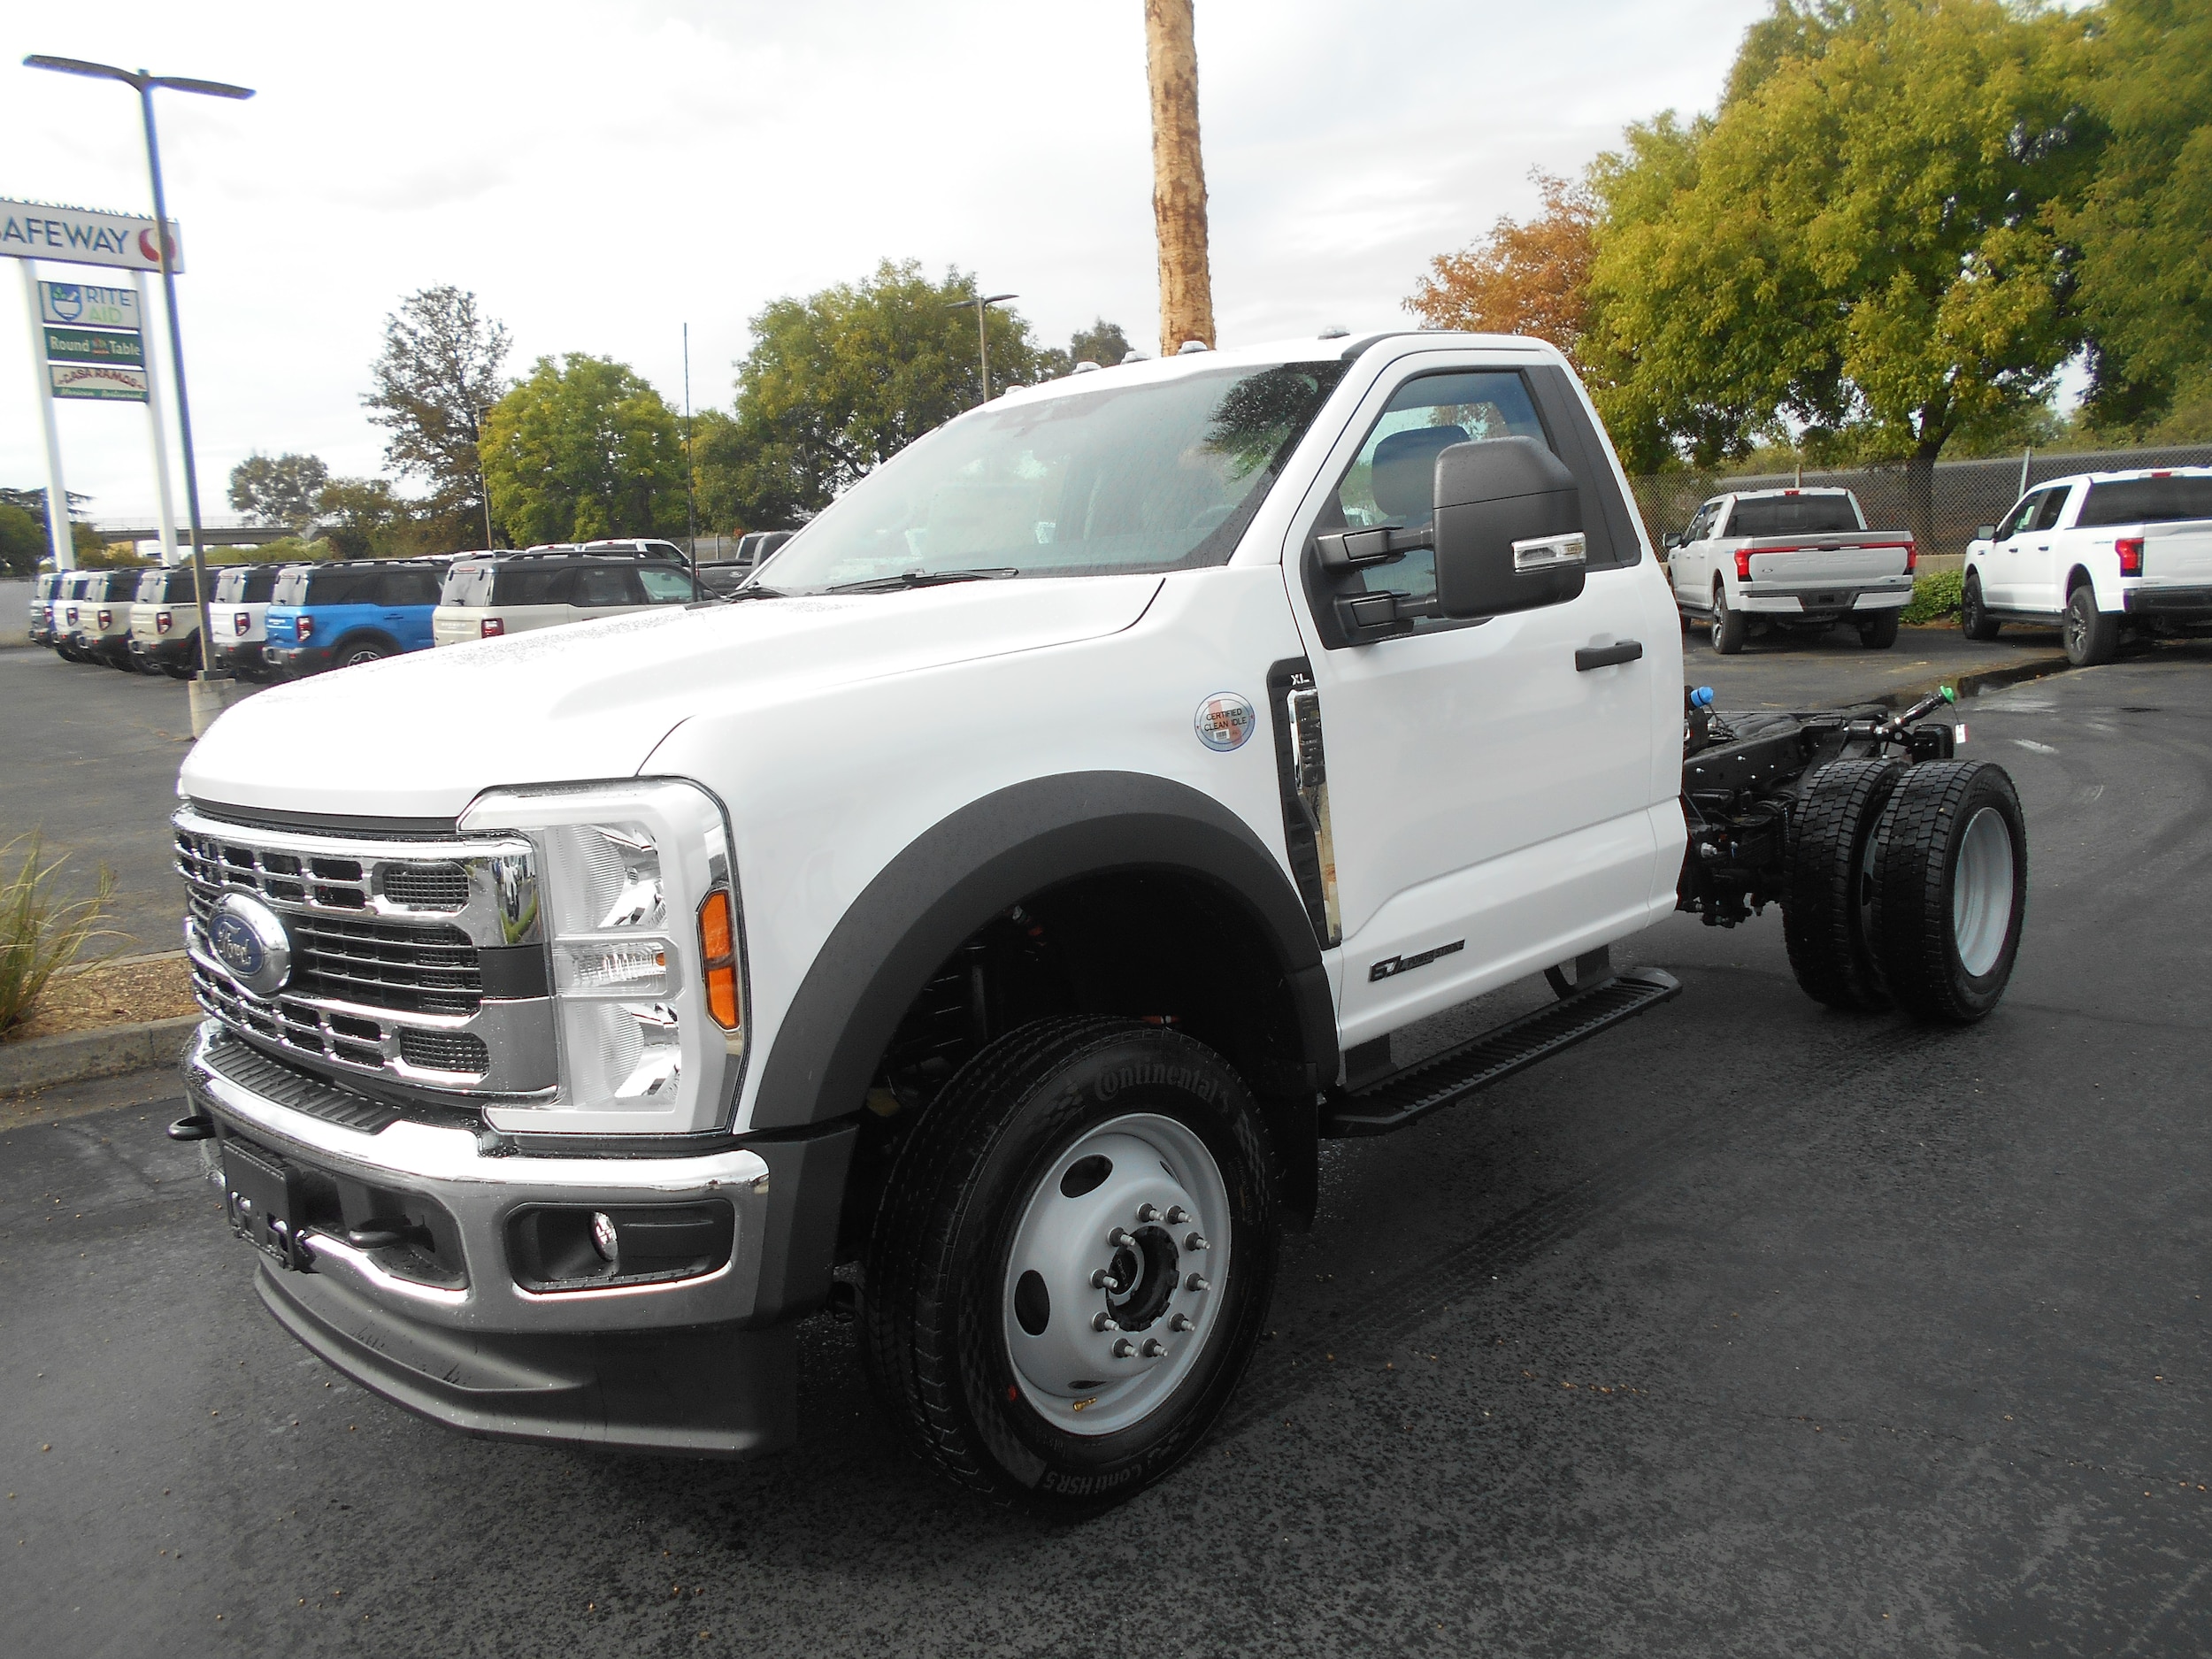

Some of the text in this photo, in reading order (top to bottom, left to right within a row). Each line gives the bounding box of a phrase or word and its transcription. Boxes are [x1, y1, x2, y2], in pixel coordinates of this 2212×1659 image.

[0, 217, 130, 255] AFEWAY
[85, 288, 132, 306] RITE
[88, 307, 122, 324] AID
[50, 335, 142, 356] Round Table
[96, 368, 138, 388] RAMOS
[1290, 672, 1310, 686] XL
[1206, 708, 1242, 721] CERTIFIED
[1204, 717, 1248, 732] CLEAN IDLE
[1094, 1057, 1218, 1104] Continental
